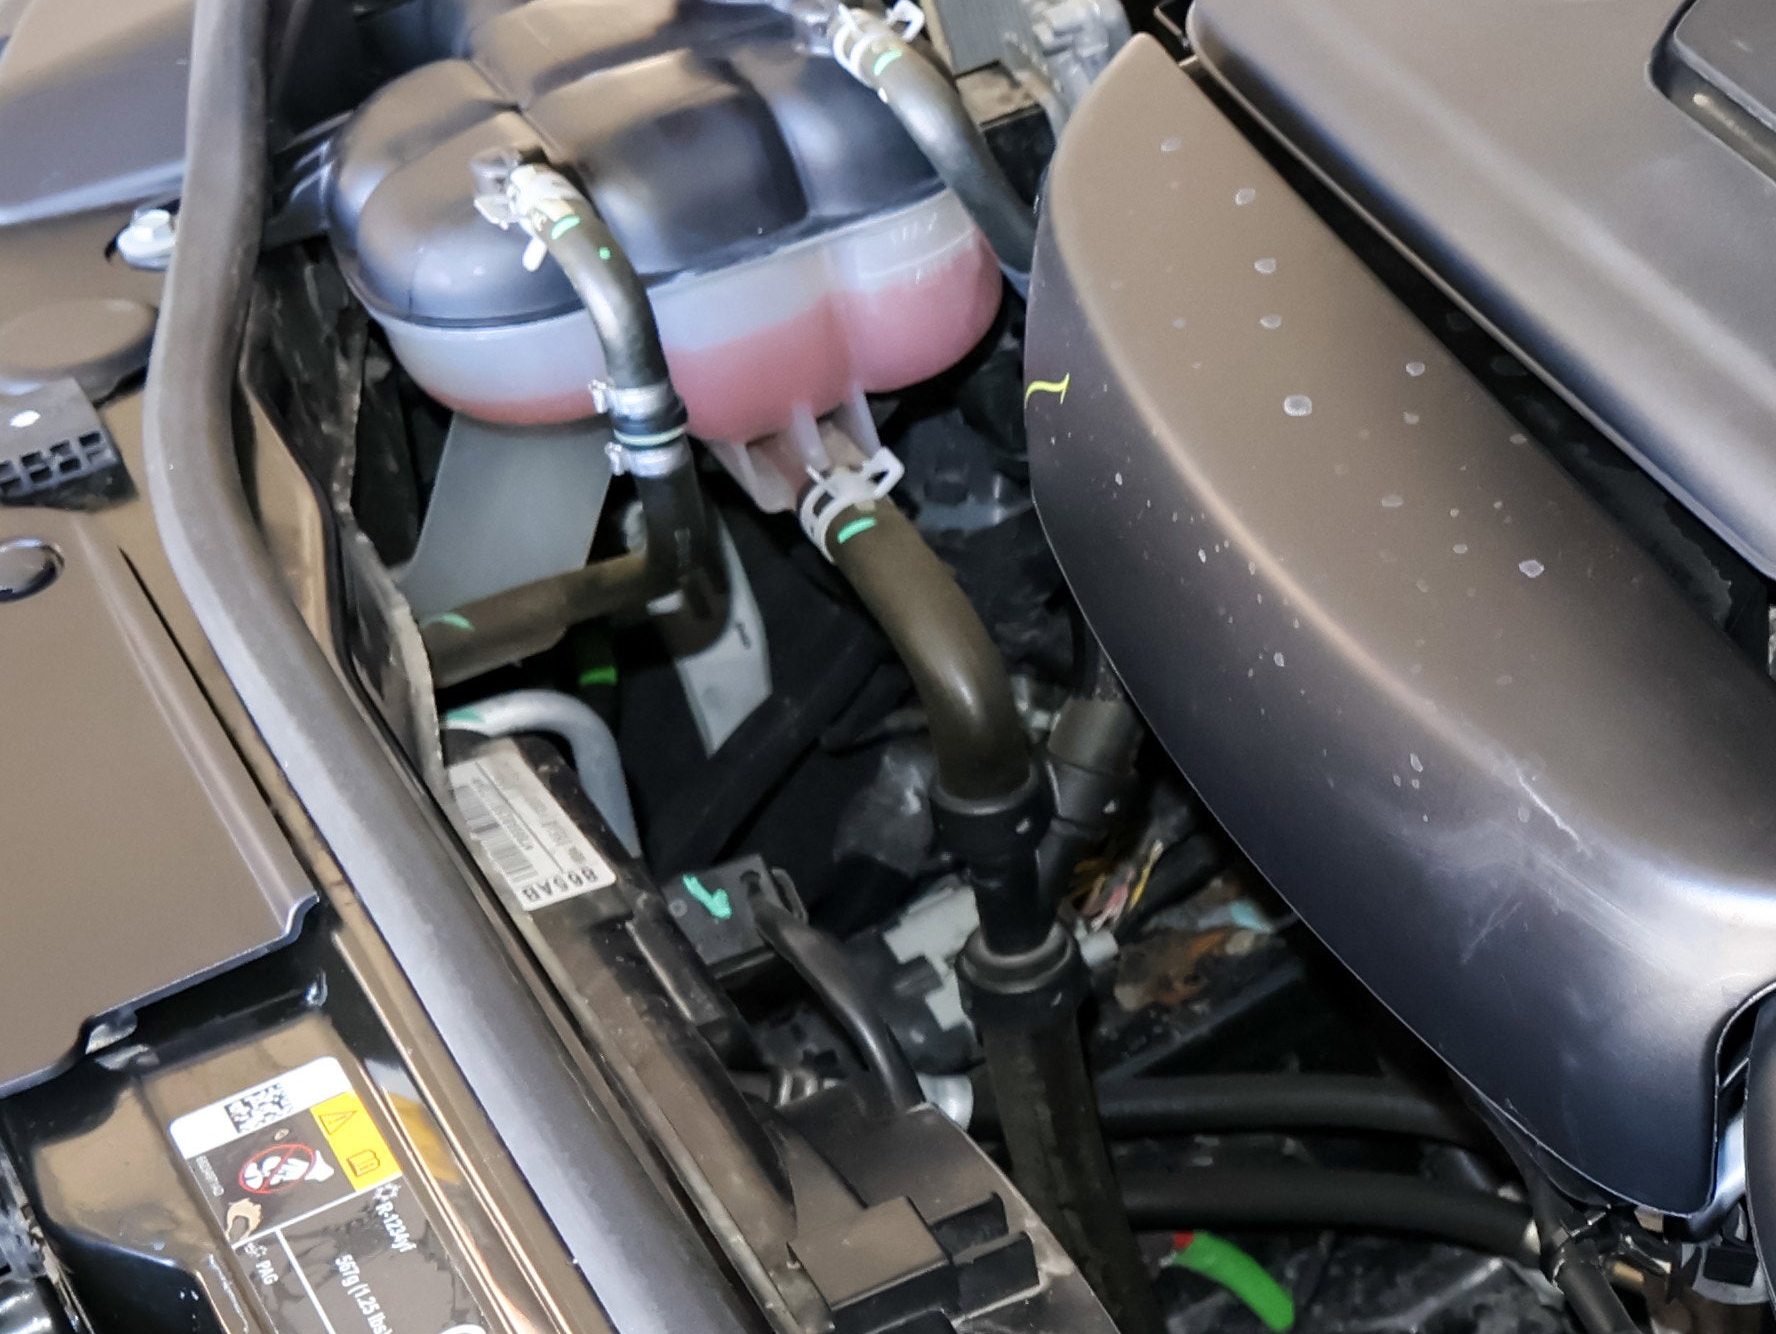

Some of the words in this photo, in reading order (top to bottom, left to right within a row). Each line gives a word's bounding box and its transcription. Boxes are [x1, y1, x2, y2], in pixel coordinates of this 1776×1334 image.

[375, 1199, 417, 1252] R-1234yf
[254, 1259, 279, 1286] PAG
[333, 1253, 365, 1286] 567g
[345, 1281, 380, 1316] (1.25
